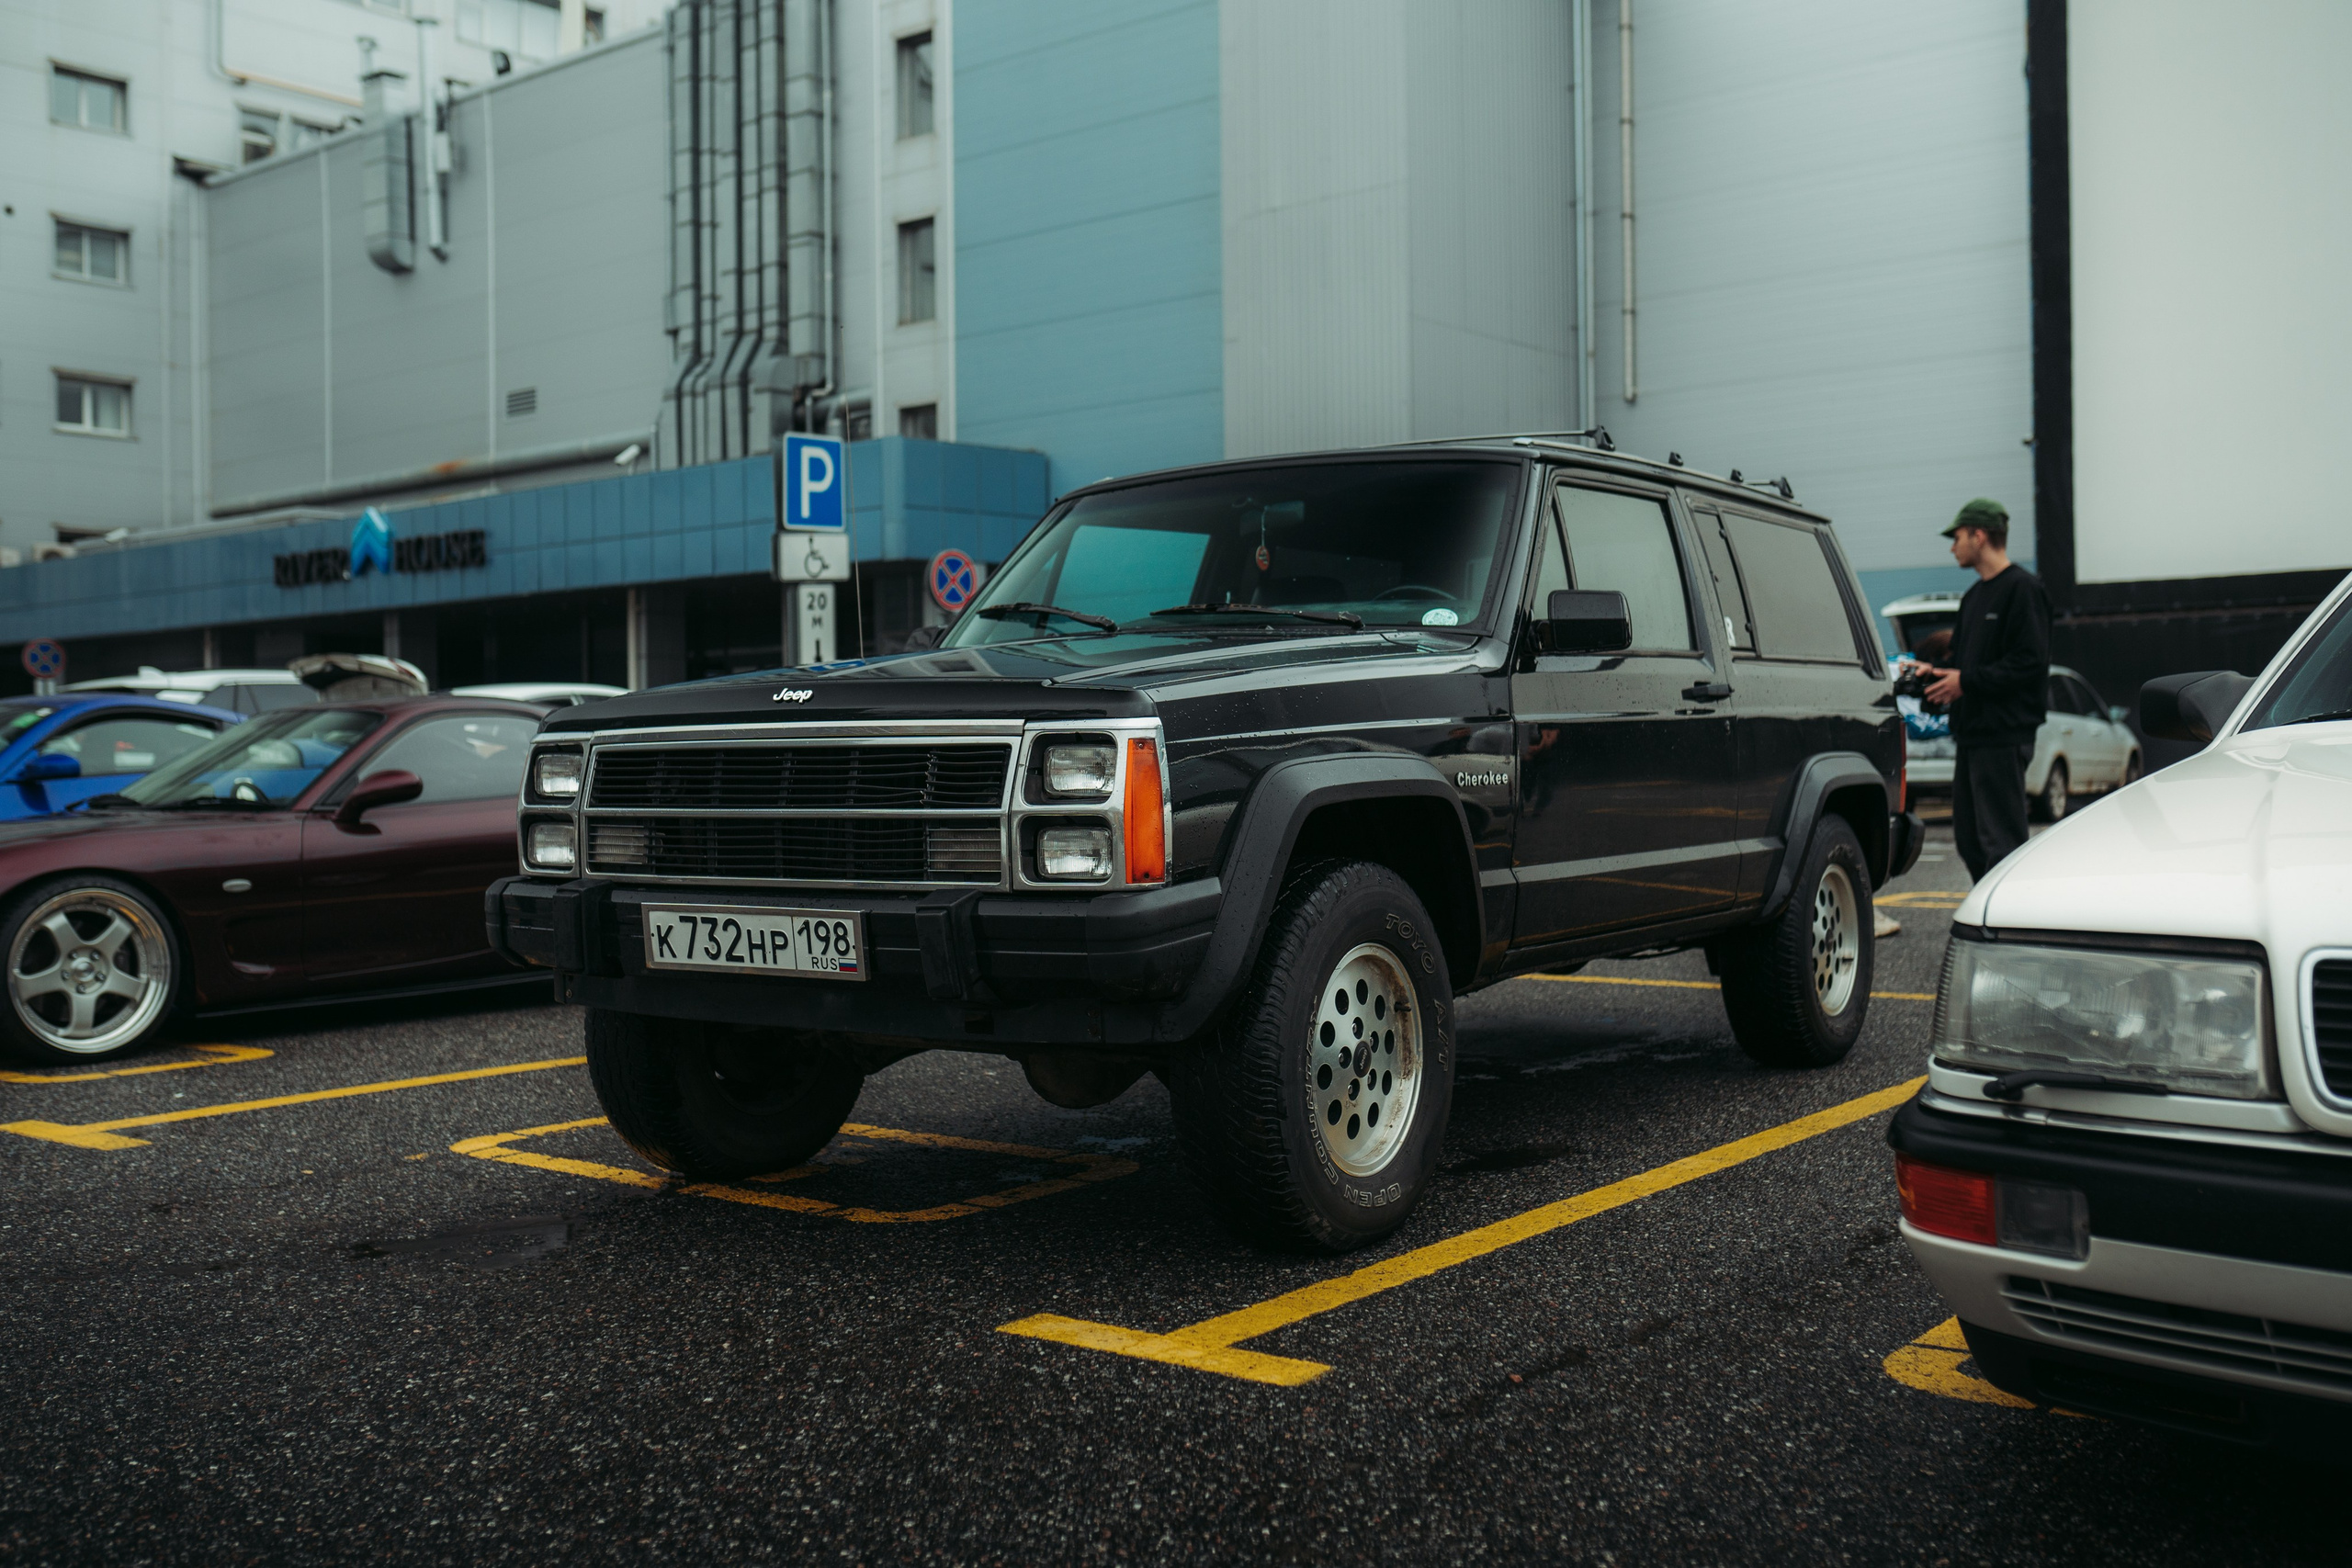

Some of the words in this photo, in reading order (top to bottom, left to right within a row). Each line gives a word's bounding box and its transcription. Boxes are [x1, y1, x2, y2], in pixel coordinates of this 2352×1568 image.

[800, 446, 834, 519] P
[274, 547, 351, 587] RIVER
[394, 529, 485, 574] HOUSE
[807, 592, 826, 611] 20
[773, 687, 813, 704] Jeep
[1457, 771, 1509, 787] Cherokee
[797, 919, 851, 956] 198
[1385, 913, 1435, 974] TOYO
[811, 956, 838, 971] RUS
[1305, 995, 1340, 1186] COUNTRY
[1343, 1182, 1402, 1208] OPEN
